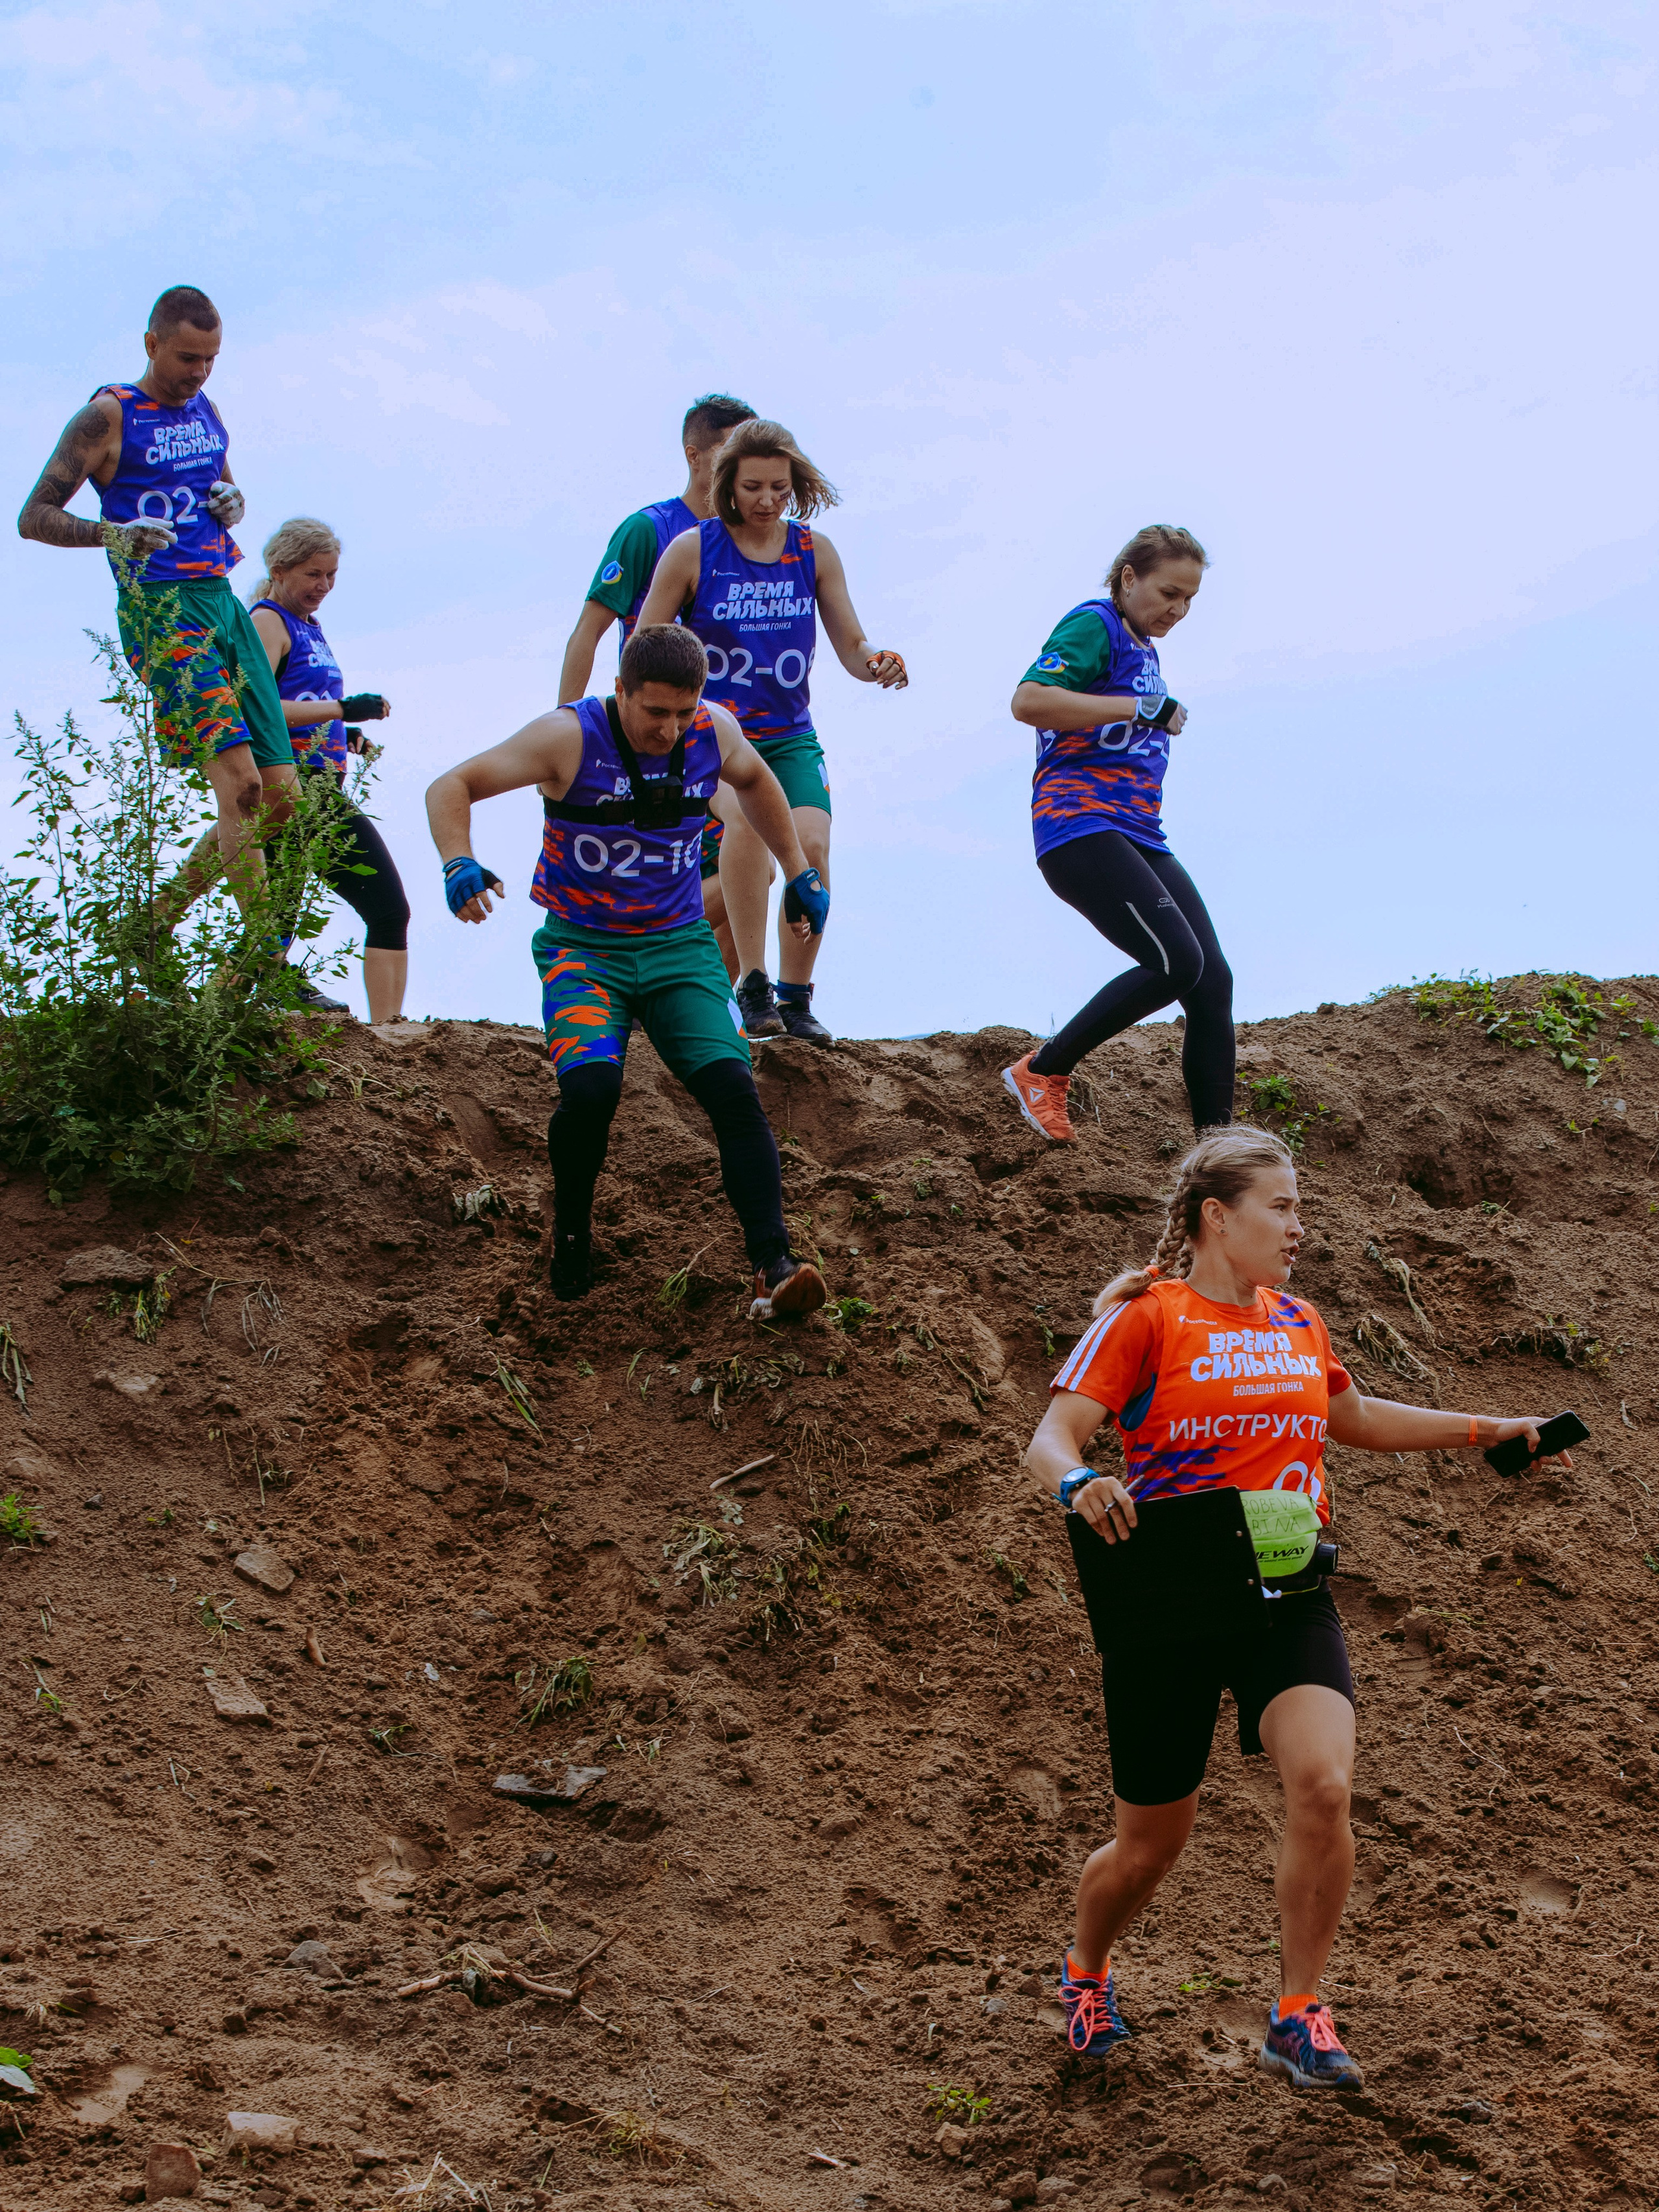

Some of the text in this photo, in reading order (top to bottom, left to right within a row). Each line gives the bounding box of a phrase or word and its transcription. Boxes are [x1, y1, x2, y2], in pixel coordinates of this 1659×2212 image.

[154, 421, 207, 445] ВРЕМЯ
[146, 435, 225, 465] СИЛЬНЫХ
[173, 456, 213, 472] БОЛЬШАЯ ГОНКА
[727, 581, 795, 601] ВРЕМЯ
[712, 597, 813, 620] СИЛЬНЫХ
[739, 622, 791, 632] БОЛЬШАЯ ГОНКА
[574, 829, 703, 878] 02-10
[1208, 1329, 1293, 1354] ВРЕМЯ
[1190, 1353, 1322, 1382] СИЛЬНЫХ
[1233, 1381, 1304, 1397] БОЛЬШАЯ ГОНКА
[1251, 1517, 1301, 1536] BINA
